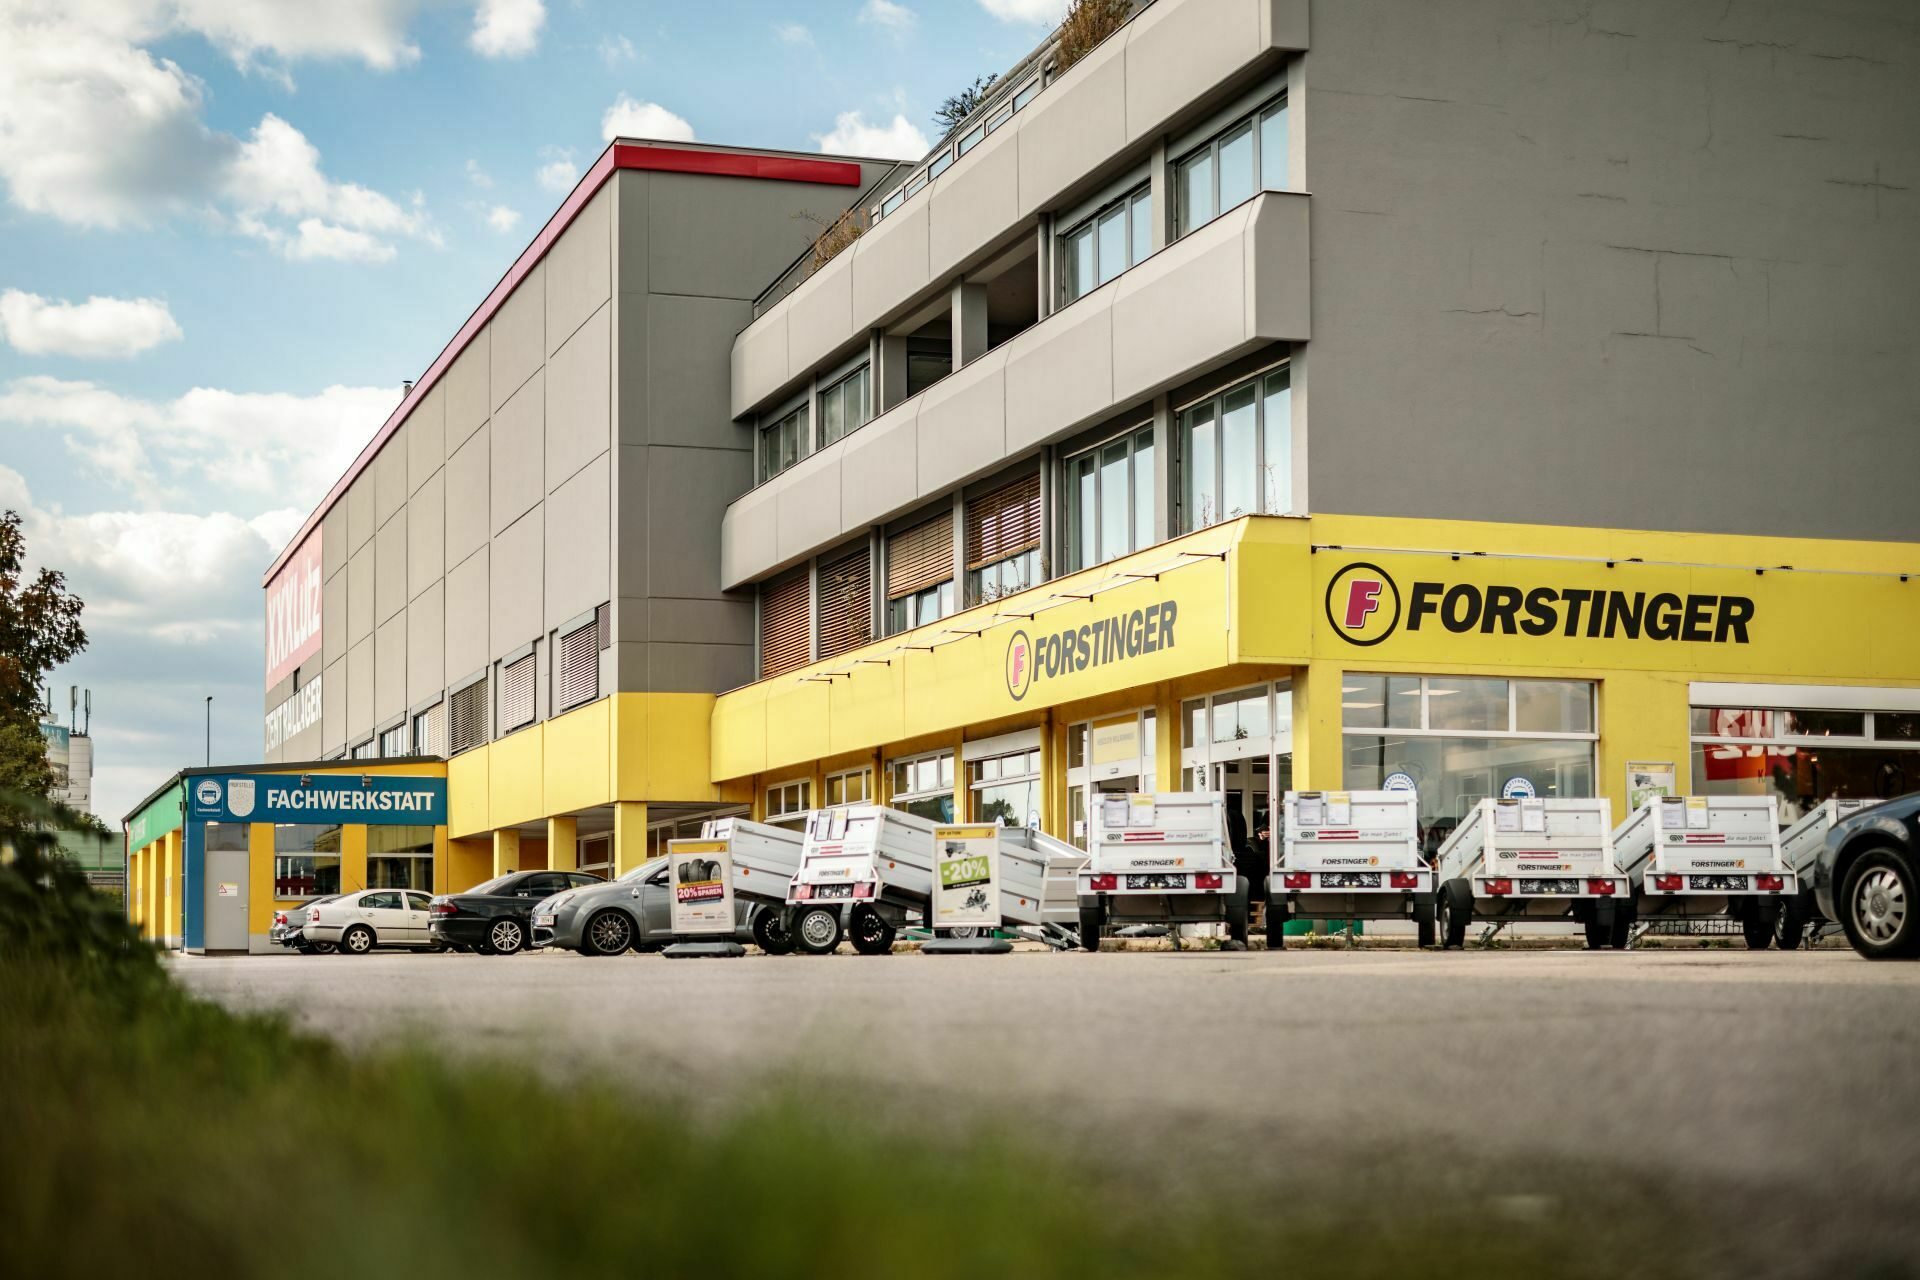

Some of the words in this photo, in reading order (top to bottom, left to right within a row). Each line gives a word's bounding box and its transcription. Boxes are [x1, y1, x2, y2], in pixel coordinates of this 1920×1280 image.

[267, 558, 320, 675] XXXLutz
[1033, 600, 1177, 682] FORSTINGER
[1406, 582, 1755, 643] FORSTINGER
[265, 674, 322, 753] ZENTRALLAGER
[267, 789, 434, 811] FACHWERKSTATT
[678, 887, 697, 899] 20%
[943, 859, 986, 881] -20%
